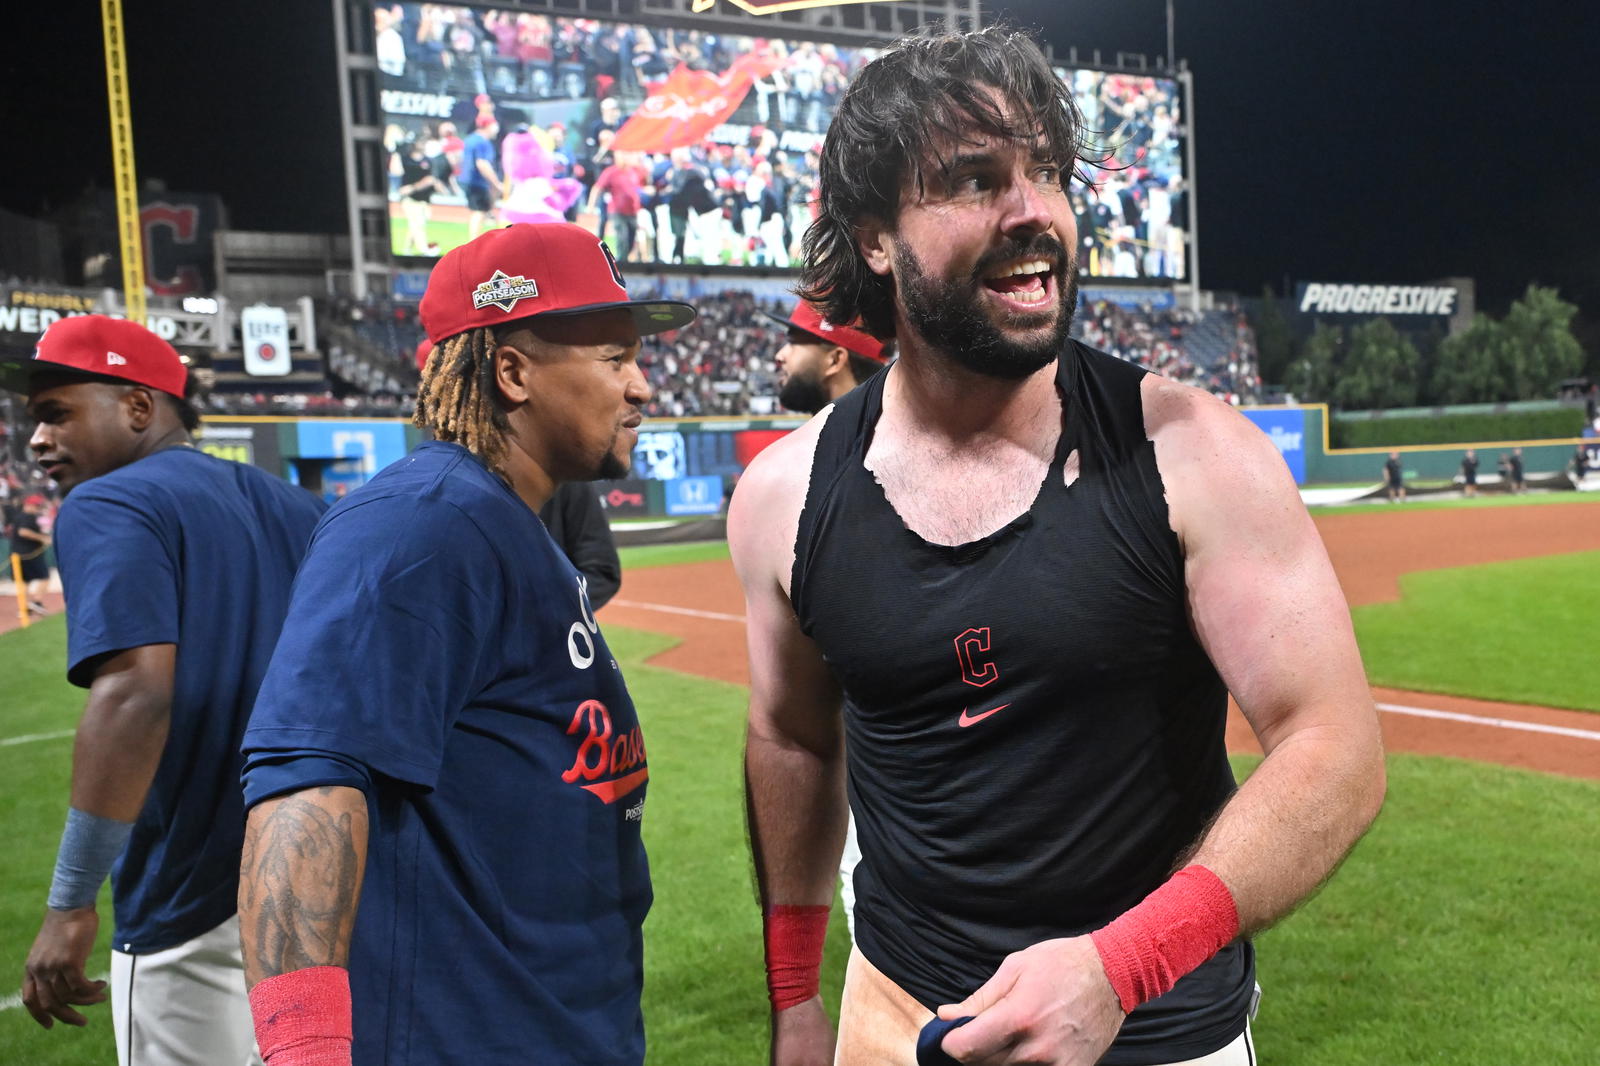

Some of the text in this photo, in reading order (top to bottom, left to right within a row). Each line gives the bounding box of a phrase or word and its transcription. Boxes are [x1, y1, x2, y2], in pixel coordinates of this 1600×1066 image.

[475, 284, 535, 305] POSTSEASON
[1300, 282, 1457, 315] PROGRESSIVE
[954, 627, 999, 688] C
